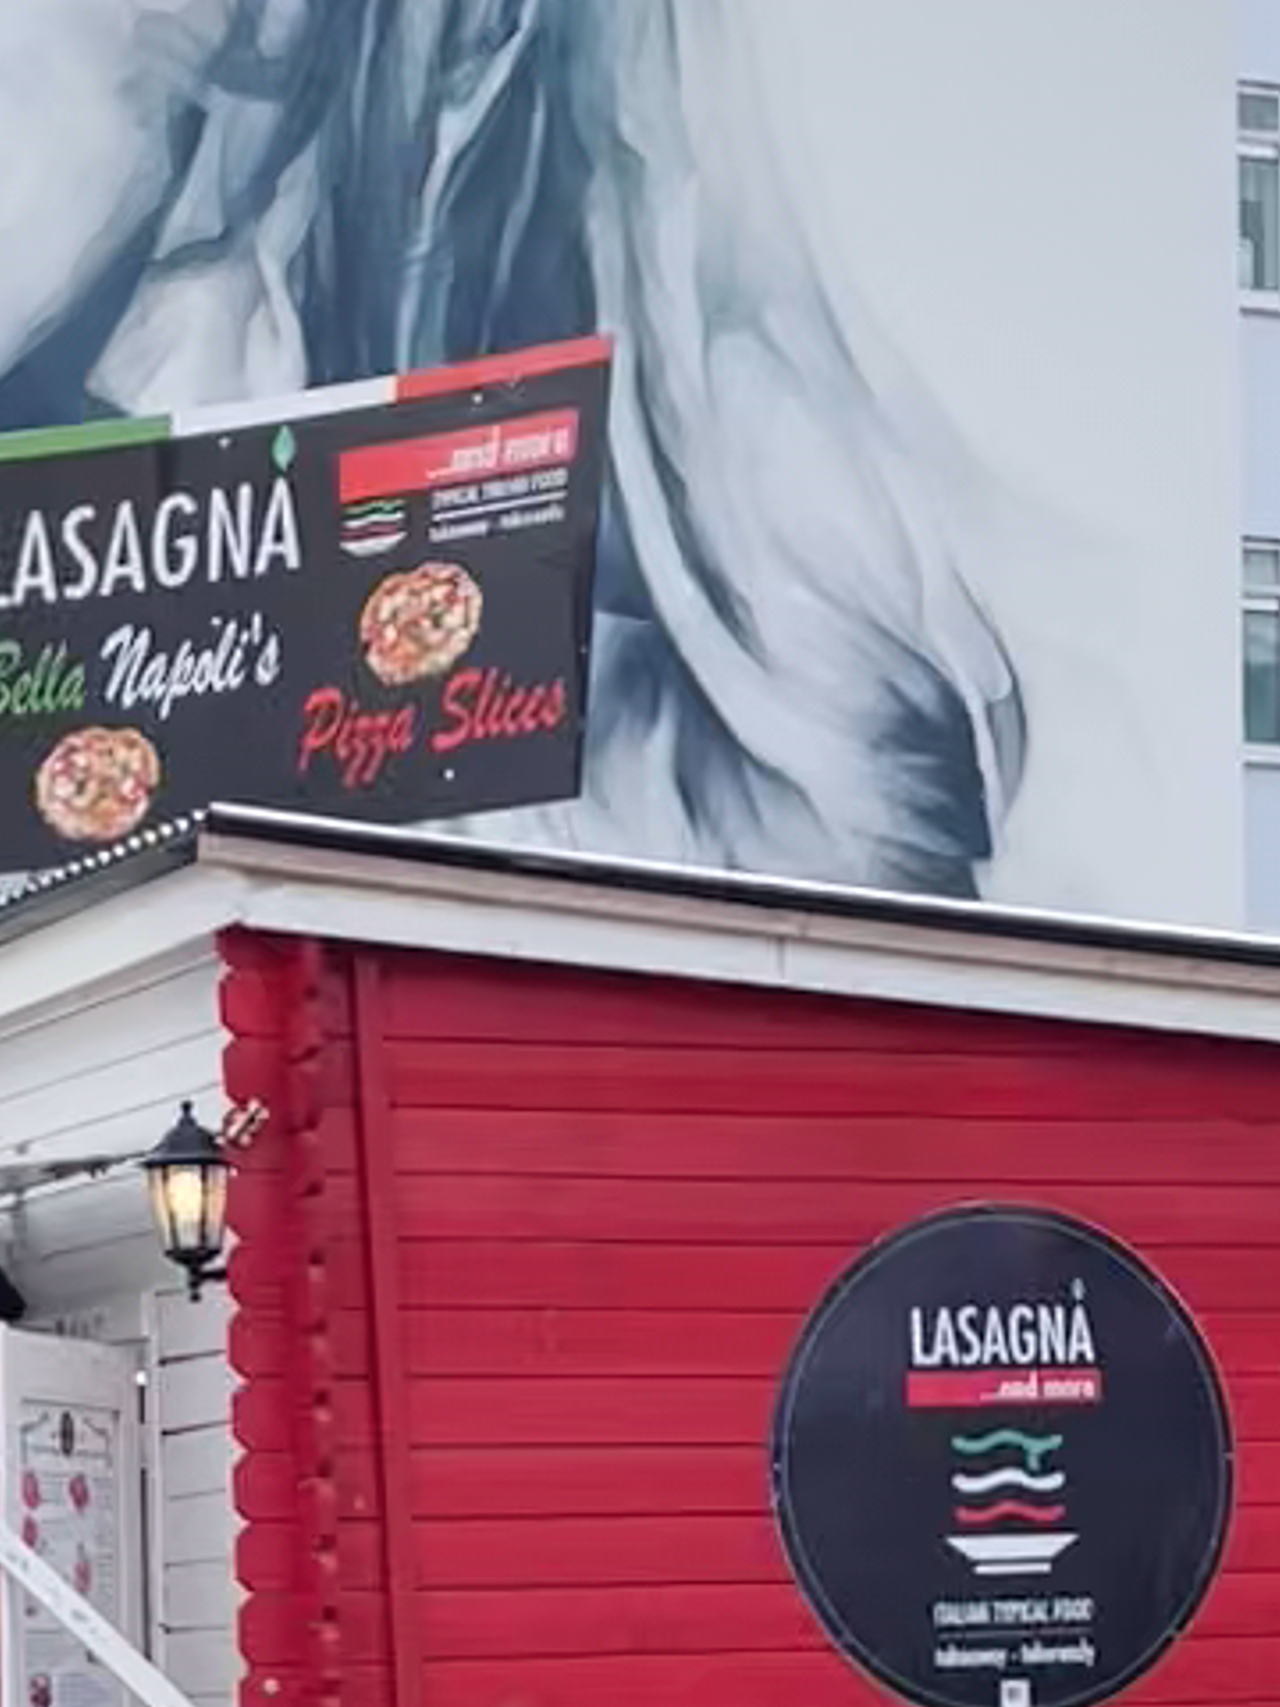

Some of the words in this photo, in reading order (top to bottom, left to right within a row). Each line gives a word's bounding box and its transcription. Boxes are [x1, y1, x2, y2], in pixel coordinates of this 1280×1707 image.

[503, 426, 570, 465] more
[532, 467, 568, 491] FOOD
[100, 611, 282, 720] Napoli's
[297, 686, 415, 789] Pizza
[432, 666, 567, 753] Slices
[1053, 1596, 1094, 1621] FOOD
